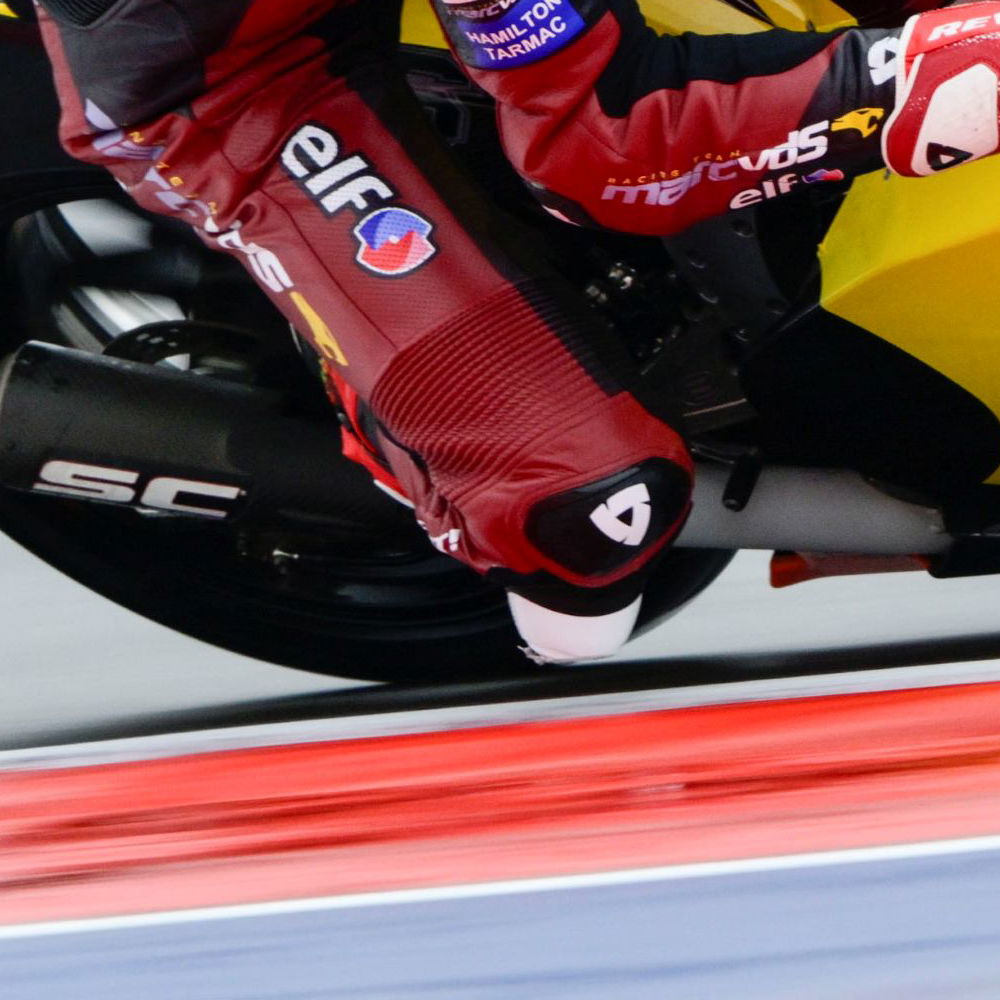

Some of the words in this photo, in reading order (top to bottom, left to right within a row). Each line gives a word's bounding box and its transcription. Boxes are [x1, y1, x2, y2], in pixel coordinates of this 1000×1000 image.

[483, 16, 567, 61] TARMAC
[280, 124, 393, 214] elf
[729, 173, 799, 210] elf
[32, 460, 241, 519] SC
